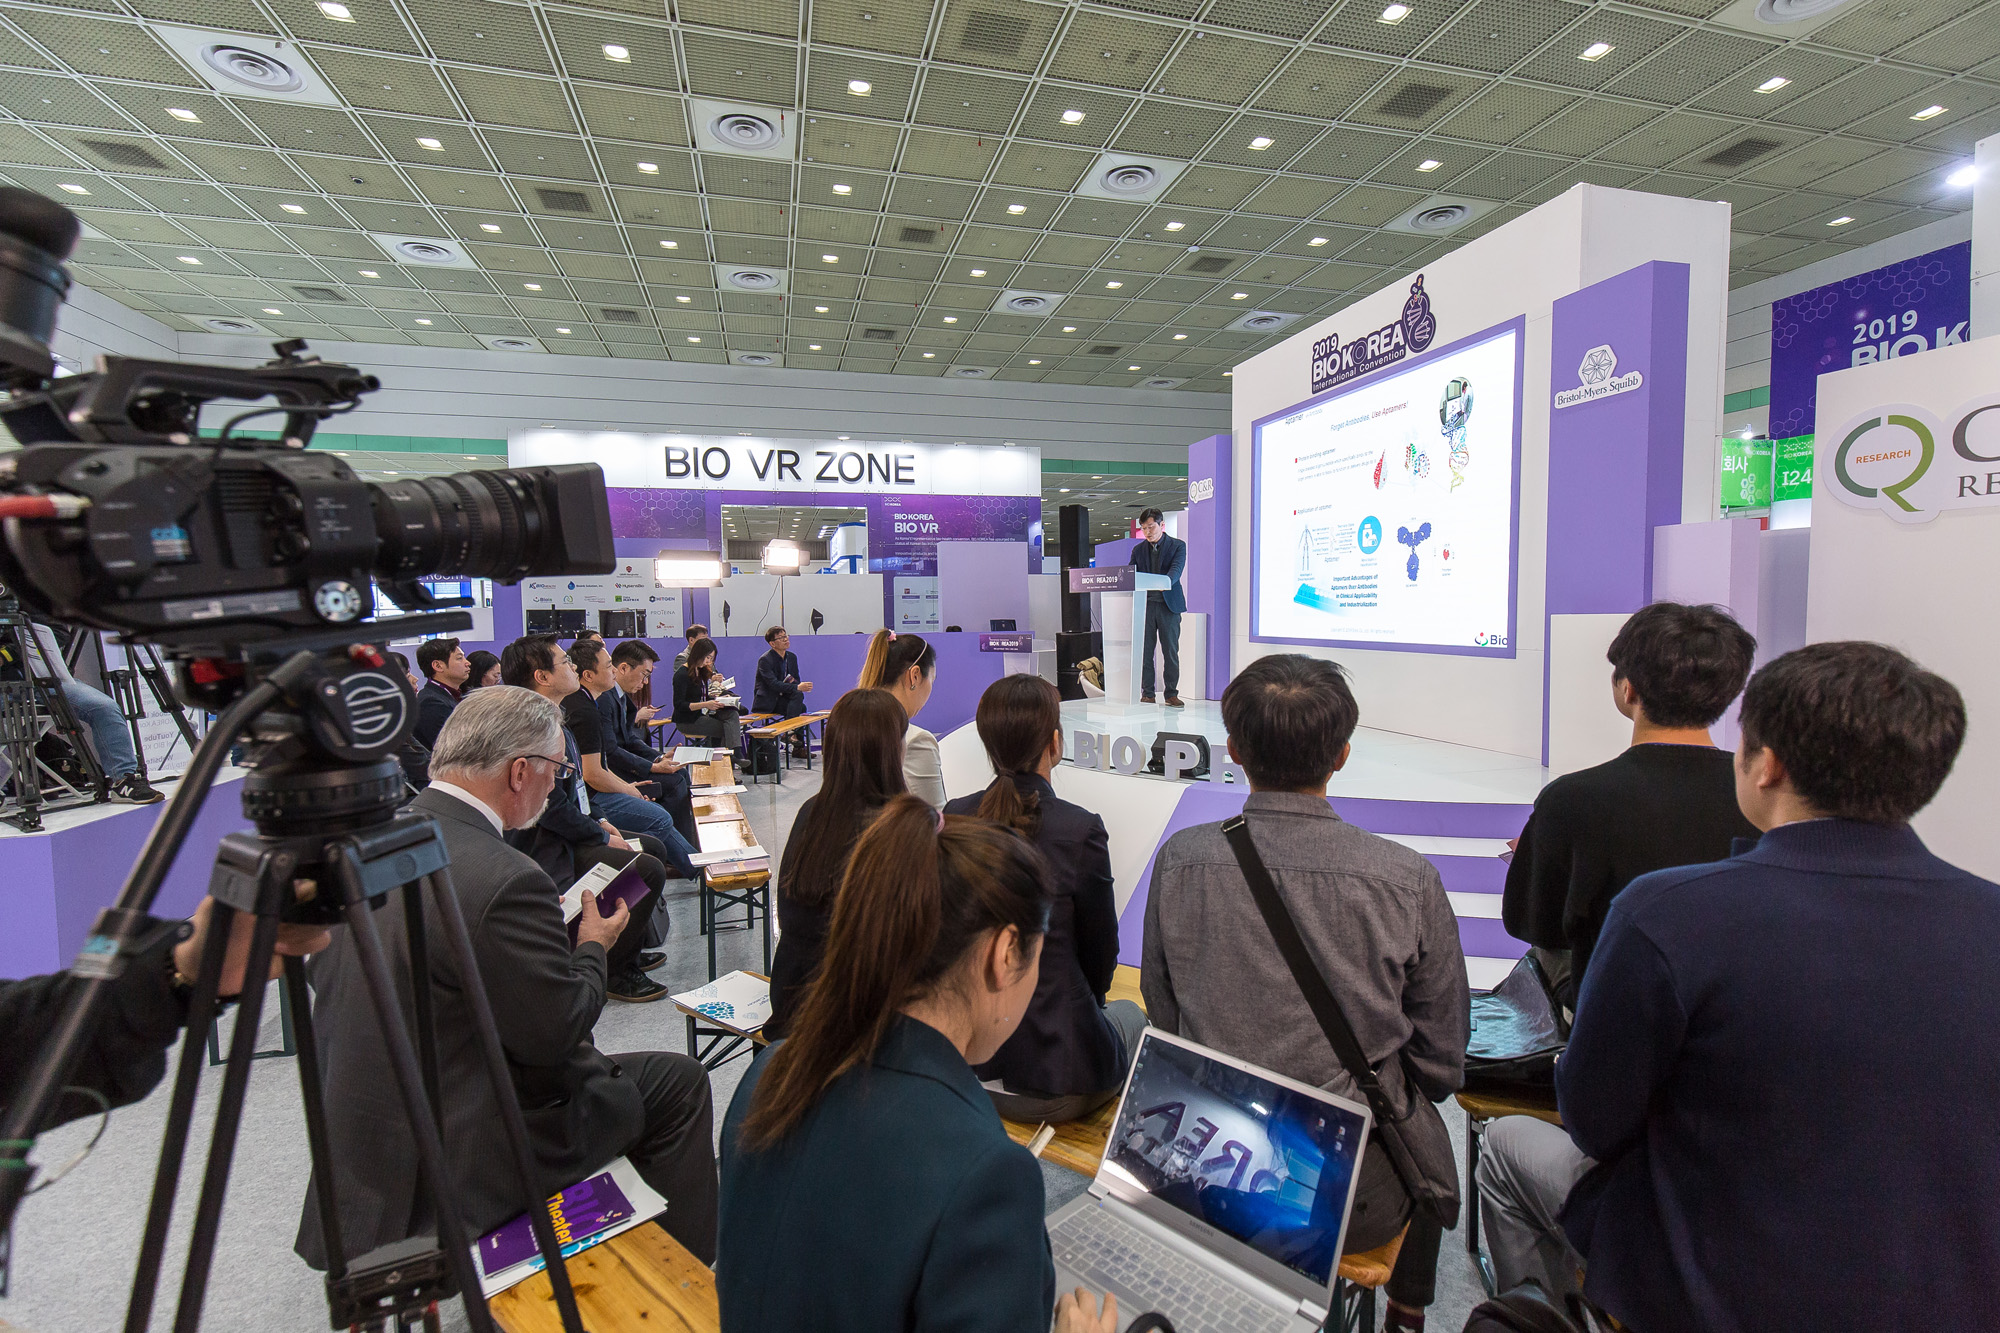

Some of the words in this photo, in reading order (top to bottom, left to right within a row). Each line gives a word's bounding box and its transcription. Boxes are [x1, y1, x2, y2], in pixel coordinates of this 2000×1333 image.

[1852, 309, 1918, 344] 2019
[1313, 335, 1337, 360] 2019
[1313, 352, 1340, 383] BIO
[1342, 323, 1405, 370] KOREA
[1851, 334, 1928, 368] BIO
[1936, 320, 1970, 349] K
[1313, 367, 1357, 392] International
[1359, 348, 1405, 373] Convention
[1557, 386, 1608, 405] Bristol-Myers
[1609, 375, 1639, 392] Squibb
[1371, 410, 1381, 419] Use
[664, 446, 731, 480] BIO
[746, 449, 801, 482] VR
[815, 451, 916, 484] ZONE
[1723, 455, 1749, 474] 회사
[1855, 449, 1911, 464] RESEARCH
[1198, 479, 1213, 493] C&R
[1956, 471, 2000, 498] RE
[894, 522, 917, 534] BIO
[920, 522, 939, 534] VR
[908, 513, 934, 521] KOREA
[1490, 634, 1508, 645] Bio
[1073, 730, 1147, 775] BIO
[545, 1192, 573, 1245] Theater
